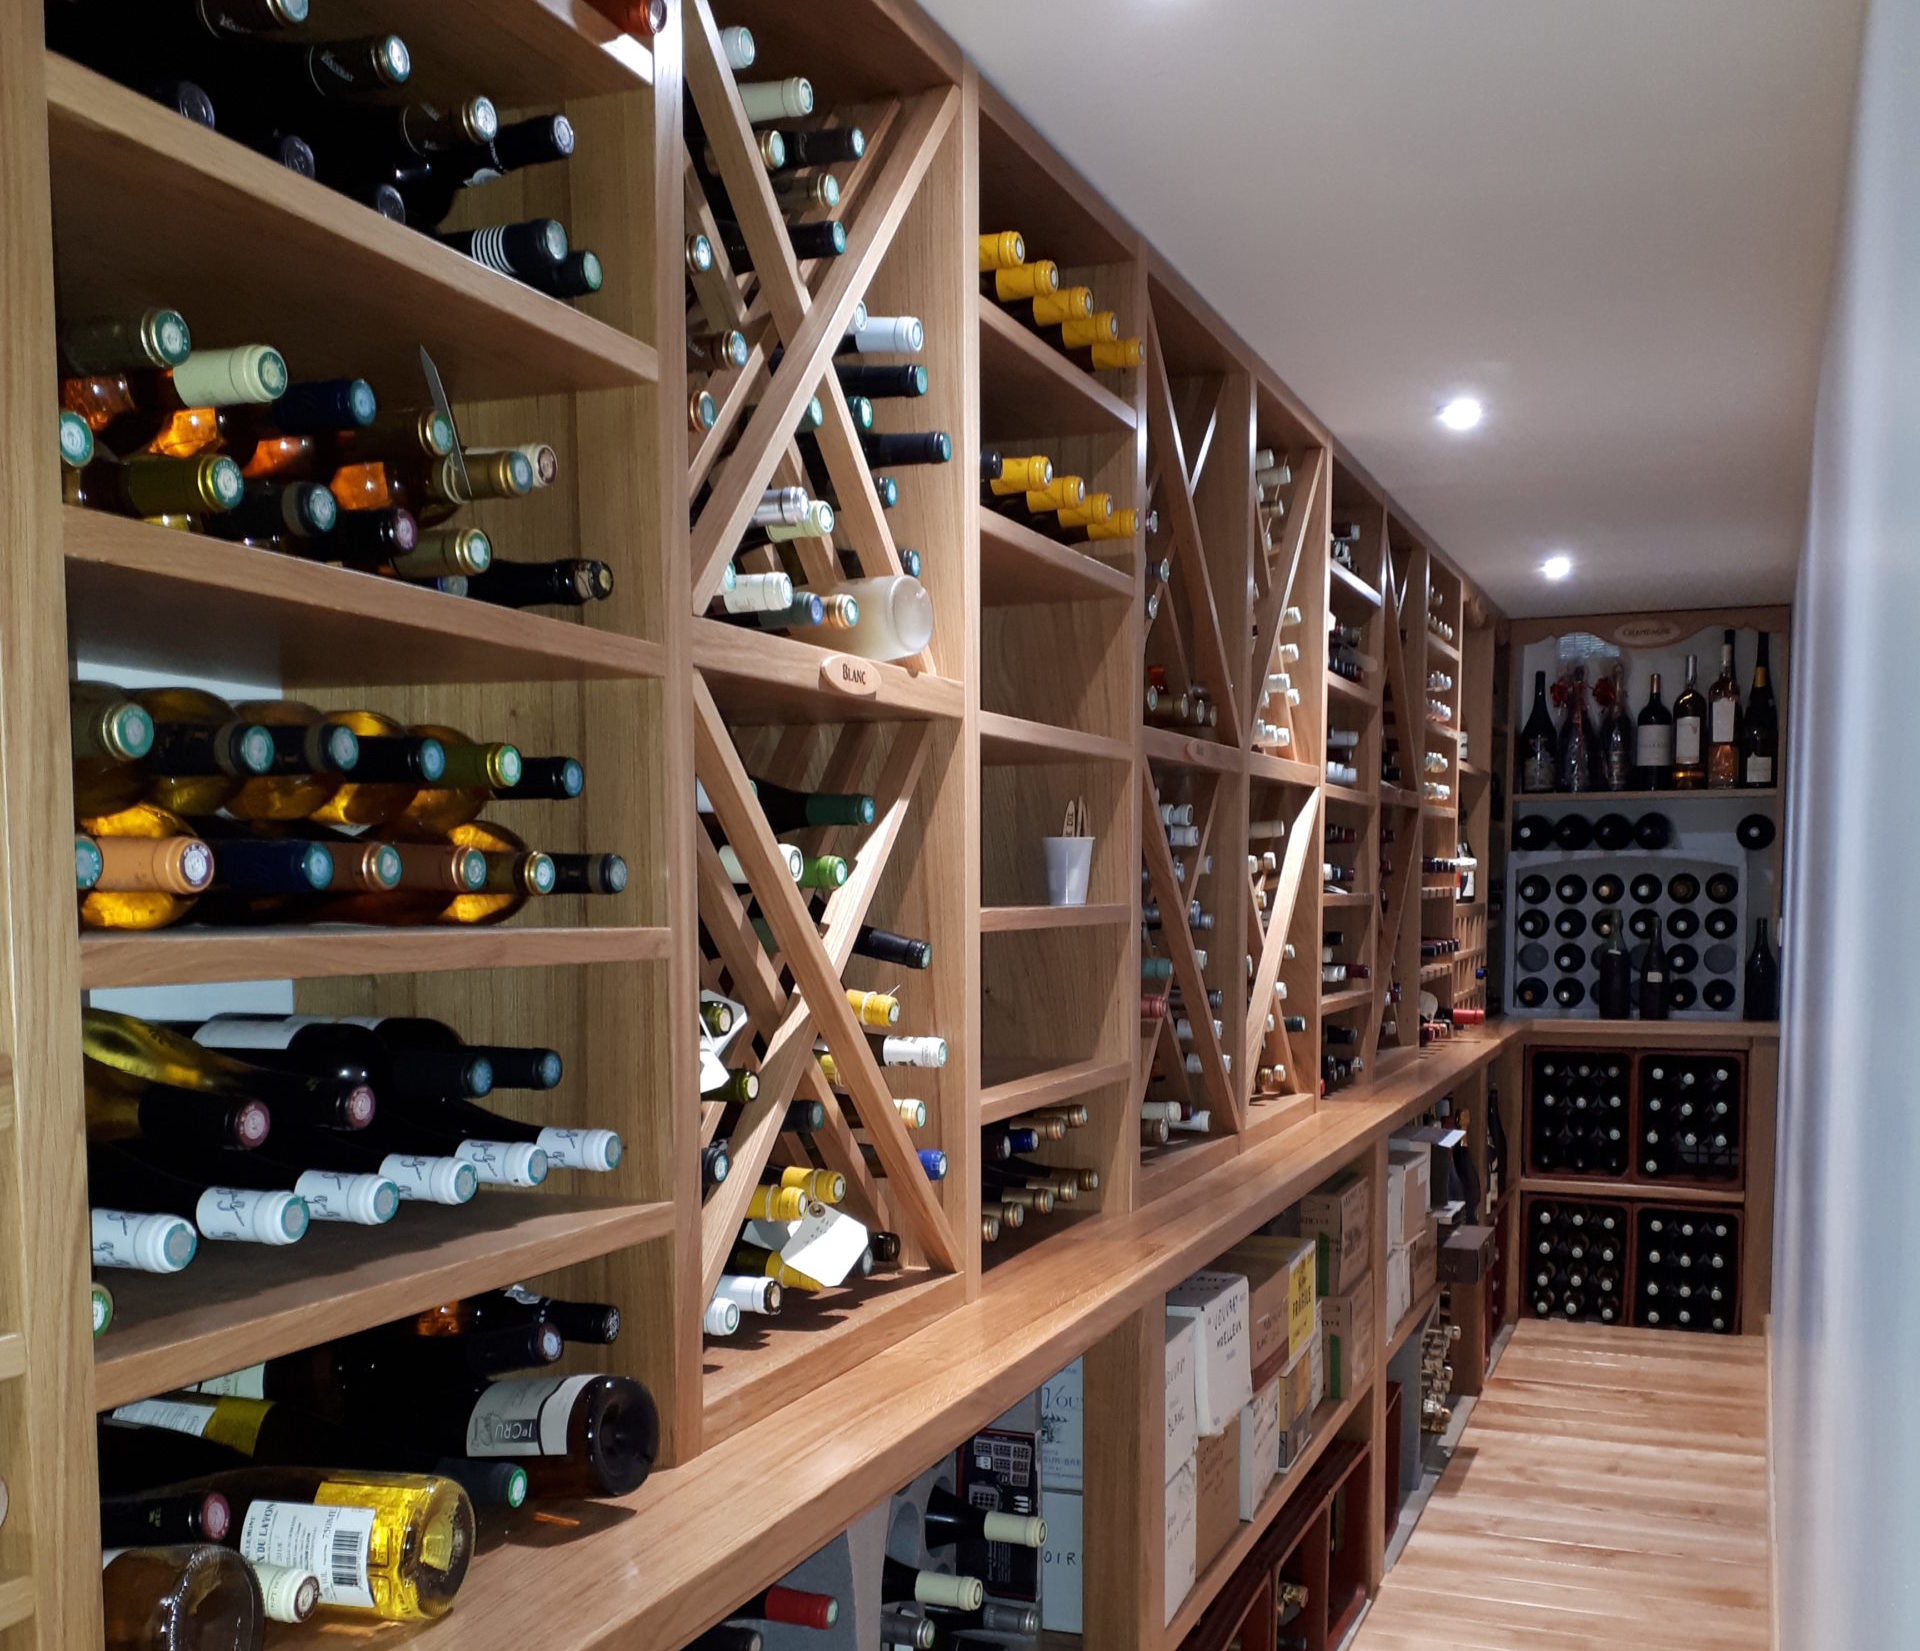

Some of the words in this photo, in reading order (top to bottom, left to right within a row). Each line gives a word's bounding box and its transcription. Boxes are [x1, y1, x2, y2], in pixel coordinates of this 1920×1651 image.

[842, 663, 866, 685] BLANC
[495, 1423, 522, 1440] CRU
[260, 1503, 275, 1537] LAYON
[257, 1541, 267, 1556] DU
